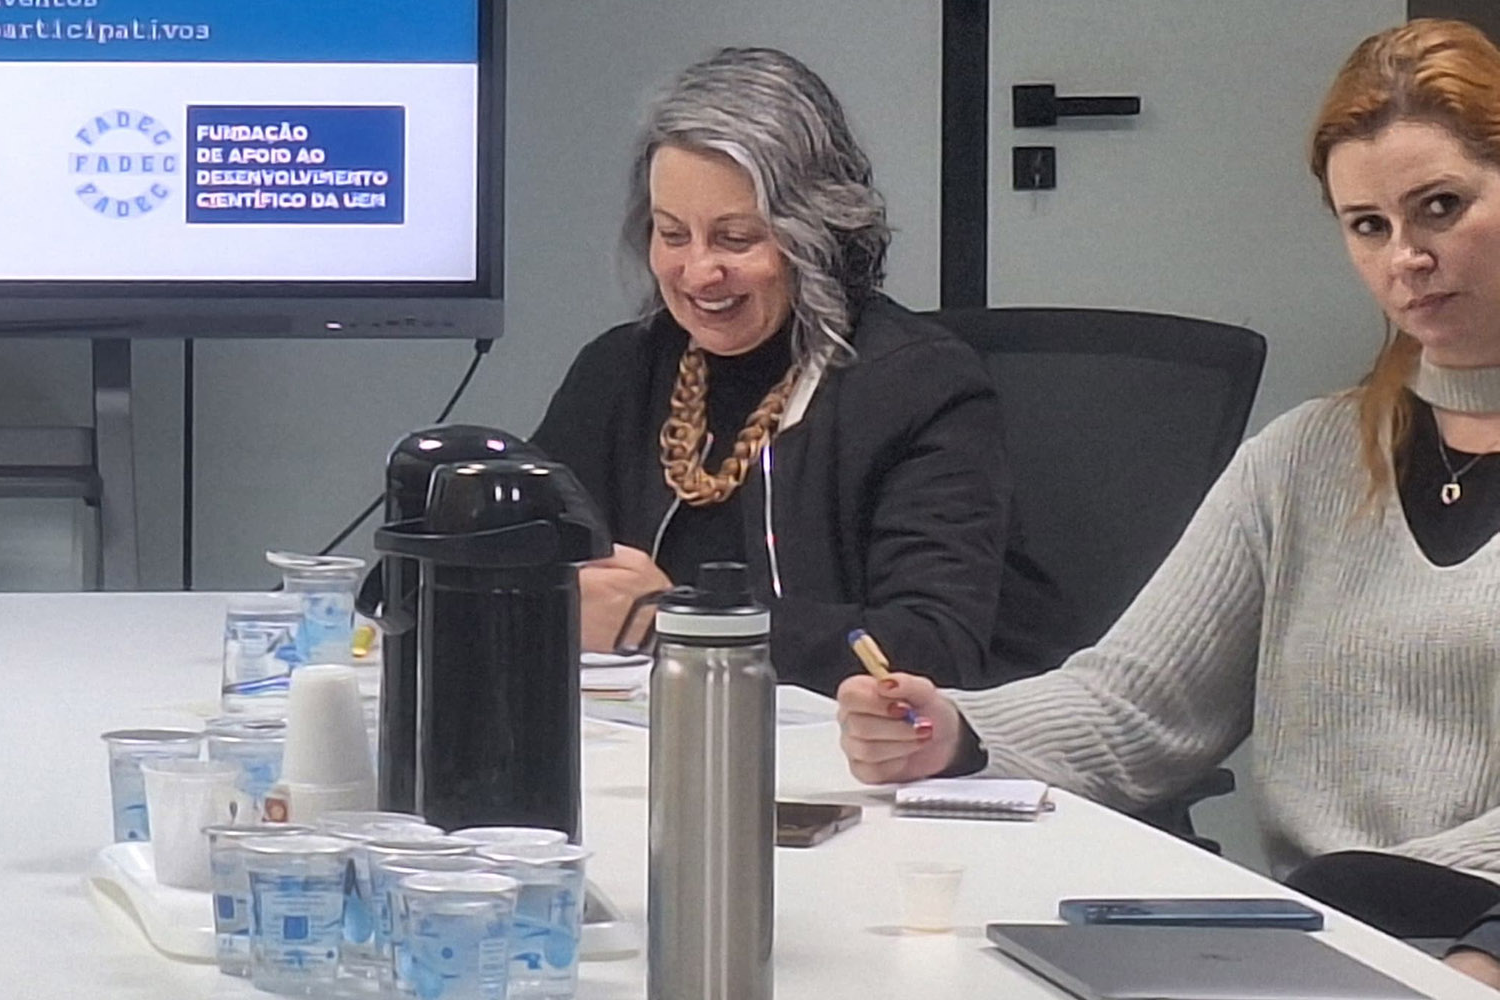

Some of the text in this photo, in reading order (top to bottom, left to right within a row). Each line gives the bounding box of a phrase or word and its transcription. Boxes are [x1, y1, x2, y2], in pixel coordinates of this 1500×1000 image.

[196, 122, 308, 144] FUNDAÇÃO
[76, 155, 175, 172] FADEC
[196, 148, 325, 164] DE APOIO AO
[196, 170, 389, 186] DESENVOLVIMENTO
[196, 189, 386, 208] CIENTÍFICO DA UEM
